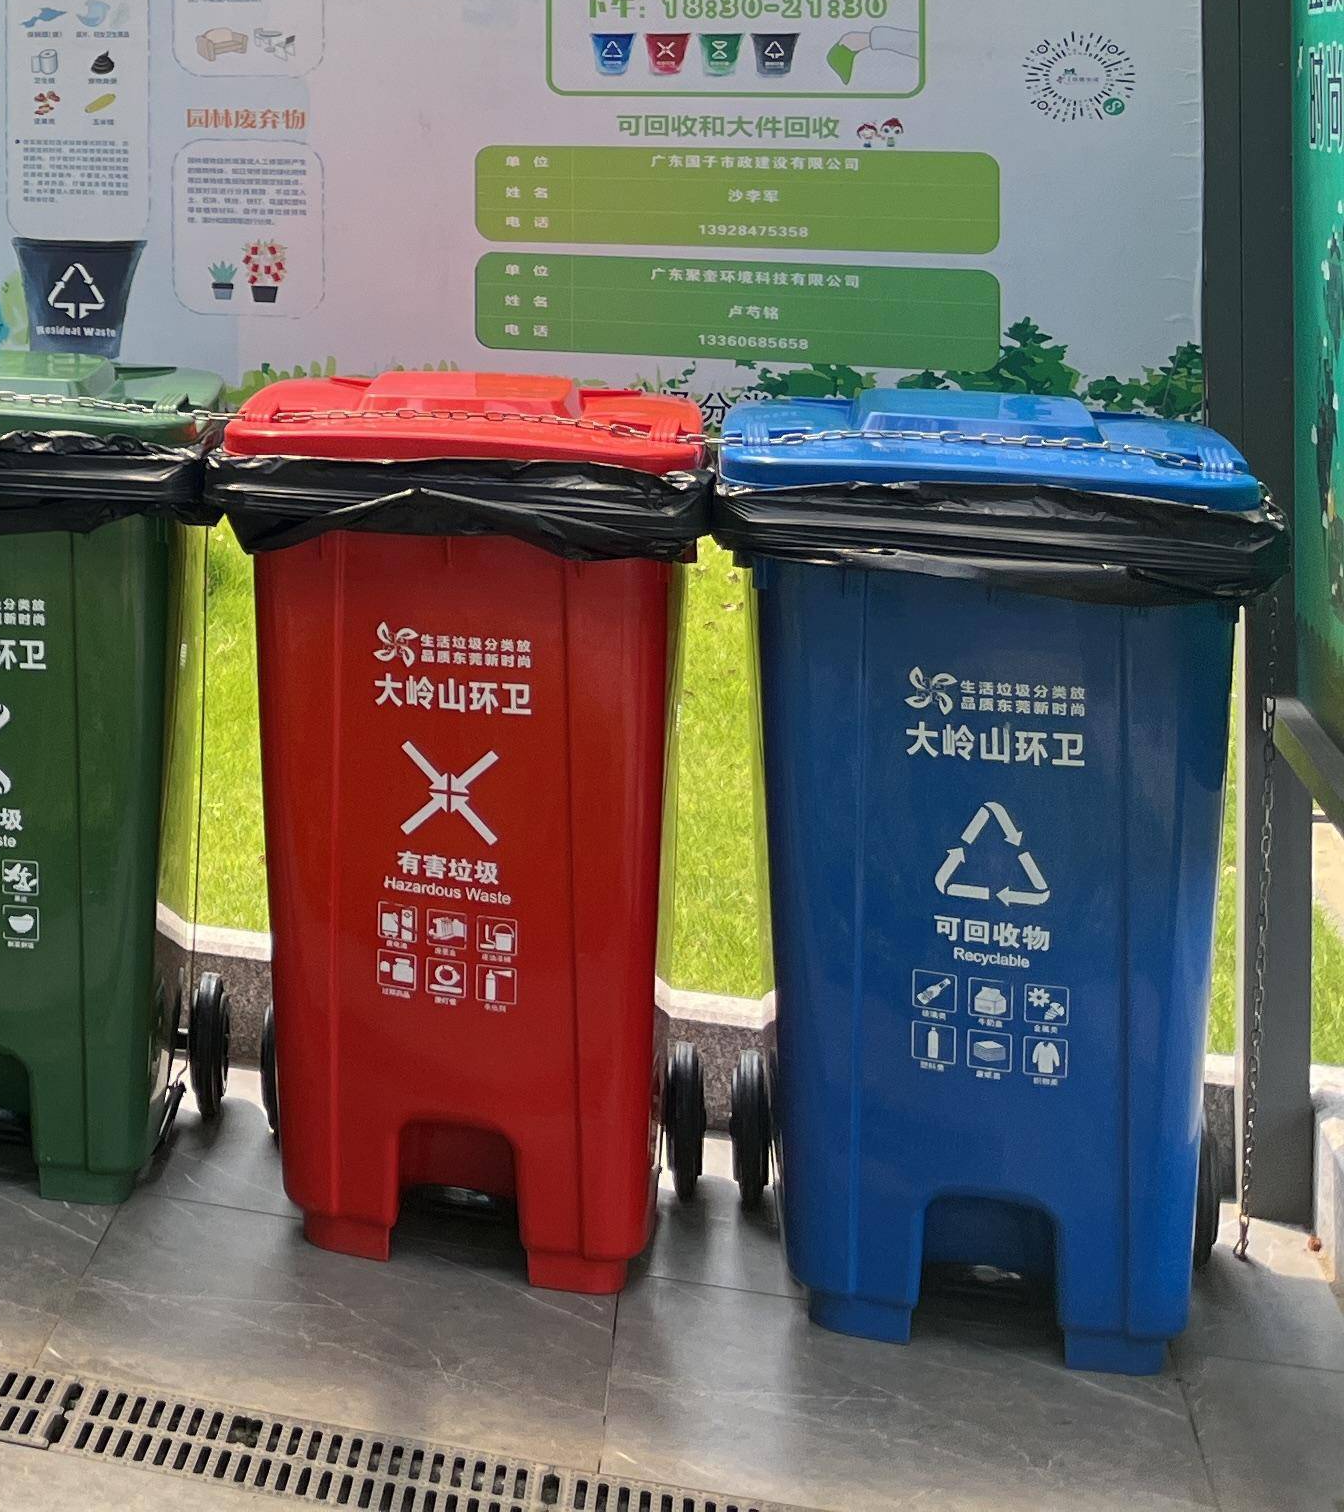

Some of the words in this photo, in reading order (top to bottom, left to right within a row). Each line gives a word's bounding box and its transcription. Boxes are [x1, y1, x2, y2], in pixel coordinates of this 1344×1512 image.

[187, 108, 305, 130] 园林废弃物
[616, 113, 841, 141] 可回收和大件回收
[505, 187, 549, 199] 姓名
[505, 216, 549, 229] 电话
[698, 224, 809, 238] 13928475358
[505, 295, 549, 308] 姓名
[83, 326, 116, 337] Waste
[505, 324, 549, 337] 电话
[697, 334, 809, 350] 13360685658
[420, 634, 531, 653] 生活垃圾分类放
[420, 650, 531, 669] 品质东莞新时尚
[374, 673, 532, 716] 大岭山环卫
[960, 680, 1086, 701] 生活垃圾分类放
[960, 696, 1086, 717] 品质东莞新时尚
[905, 721, 1086, 768] 大岭山环卫
[396, 850, 499, 886] 有害垃圾
[384, 876, 462, 900] Hazardous
[465, 885, 511, 905] Waste
[934, 915, 1050, 951] 可回收物
[953, 946, 1030, 969] Recyclable
